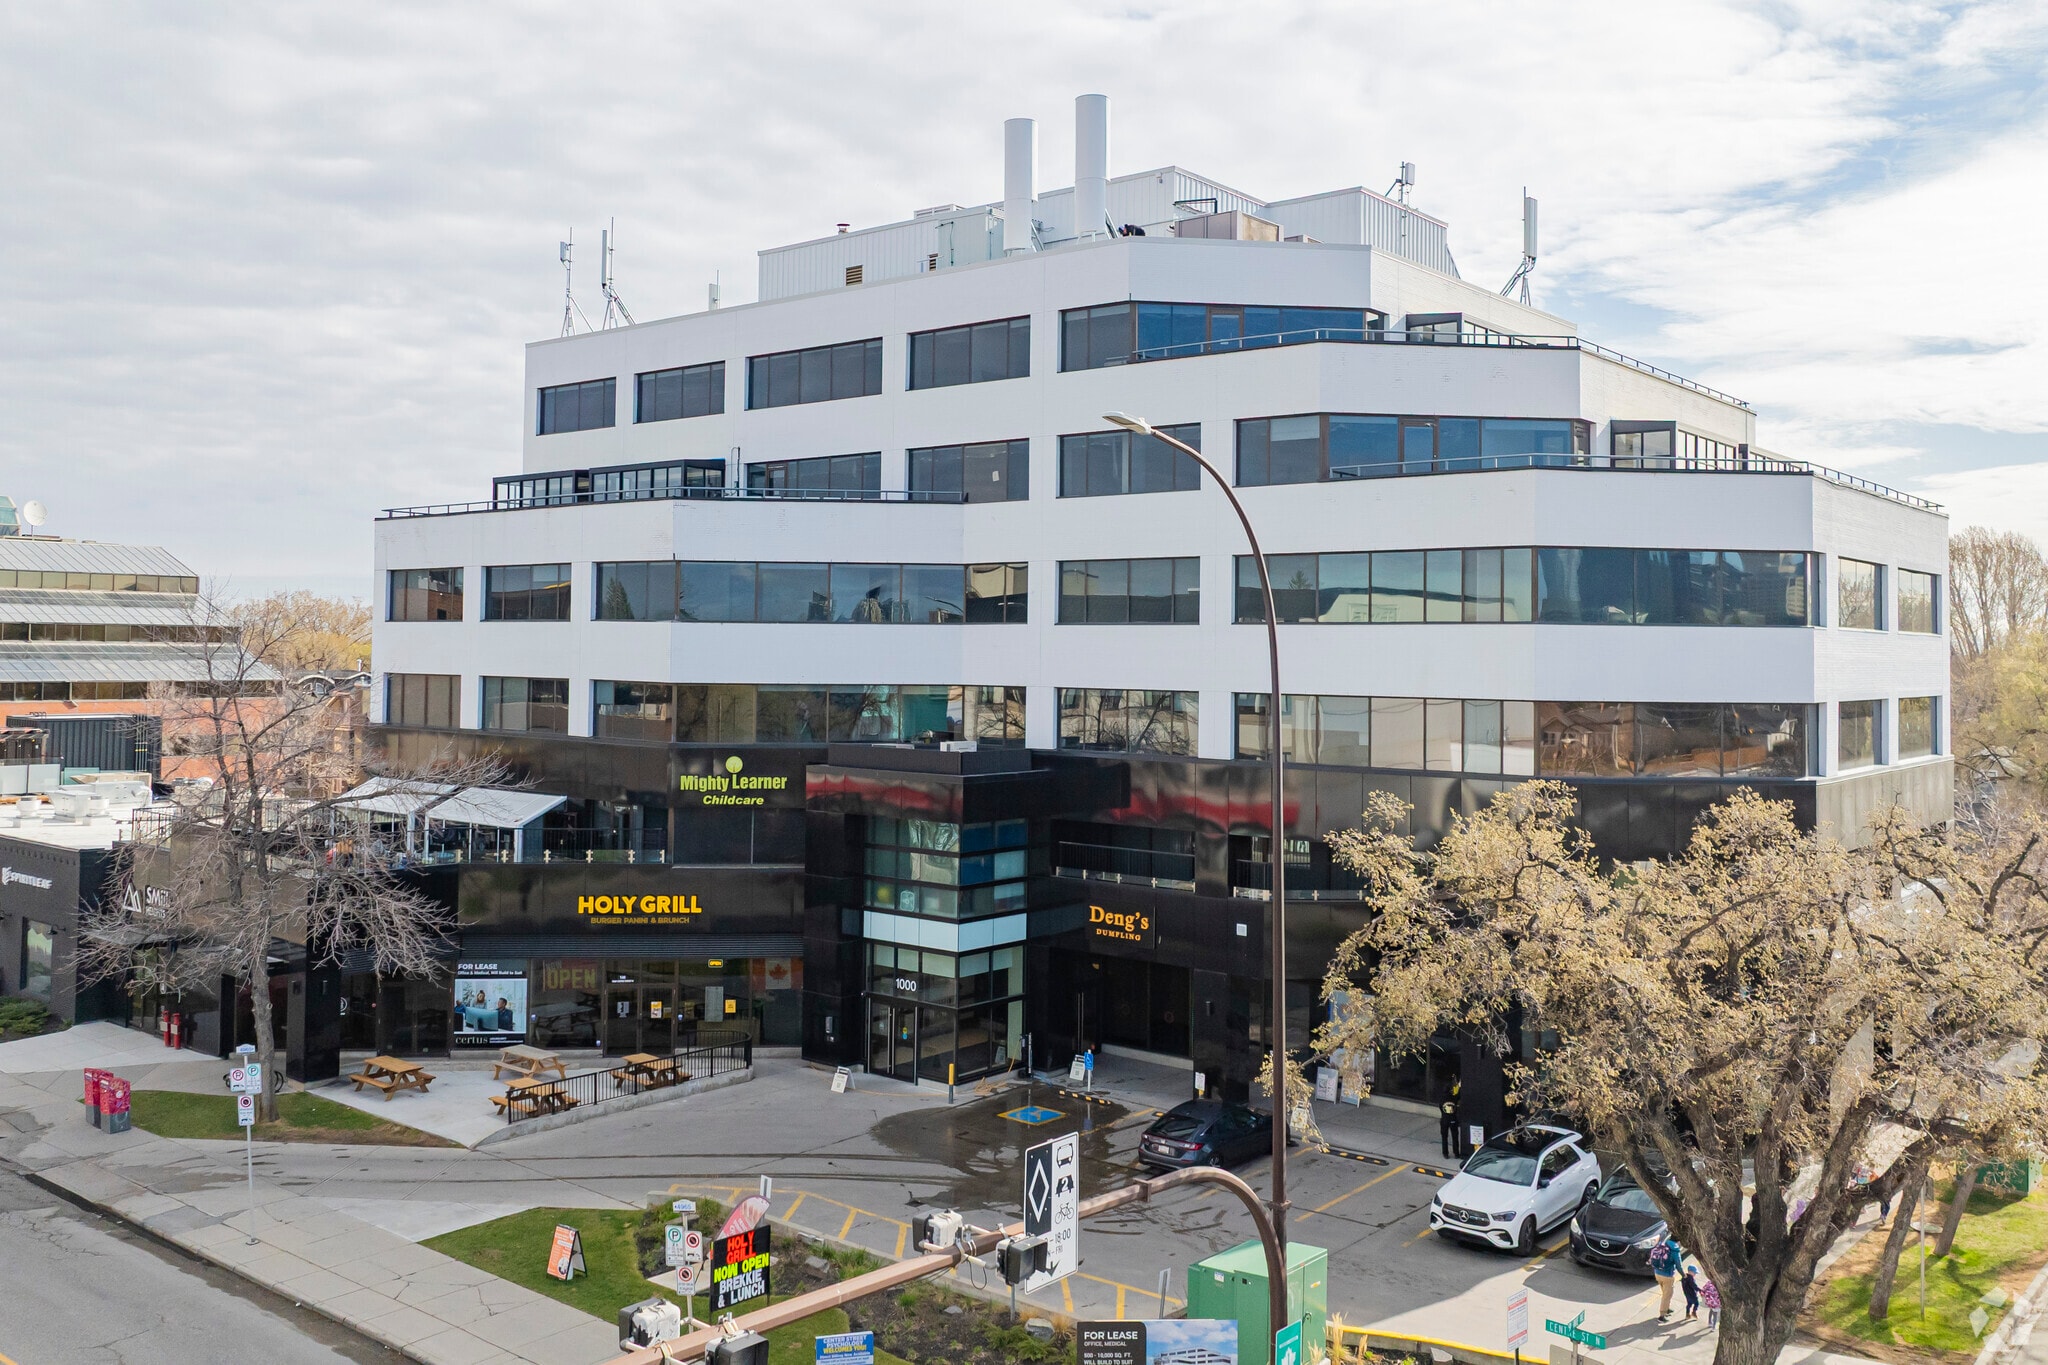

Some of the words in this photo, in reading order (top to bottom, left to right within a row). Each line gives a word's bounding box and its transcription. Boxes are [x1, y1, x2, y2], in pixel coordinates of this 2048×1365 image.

[680, 775, 729, 792] Mighty
[732, 774, 787, 790] Learner
[703, 795, 764, 805] Childcare
[578, 895, 637, 914] HOLY
[640, 895, 702, 914] GRILL
[591, 917, 622, 925] BURGER
[624, 917, 649, 925] PANINI
[651, 917, 657, 925] &
[658, 917, 690, 925] BRUNCH
[1089, 905, 1149, 932] Deng's
[1096, 928, 1141, 941] DUMPLING
[547, 968, 596, 989] OPEN
[896, 978, 917, 992] 1000
[455, 1036, 488, 1045] certus
[1061, 1177, 1069, 1192] 2
[672, 1230, 678, 1240] P
[727, 1230, 755, 1252] HOLY
[726, 1246, 756, 1265] GRILL
[713, 1263, 738, 1283] NOW
[742, 1252, 769, 1273] OPEN
[719, 1268, 763, 1294] BREKKIE
[717, 1295, 725, 1308] &
[731, 1281, 765, 1305] LUNCH
[1084, 1331, 1105, 1340] FOR
[1107, 1331, 1138, 1340] LEASE
[1581, 1332, 1589, 1342] ST
[1596, 1337, 1600, 1345] N
[823, 1346, 853, 1354] WELCOMES
